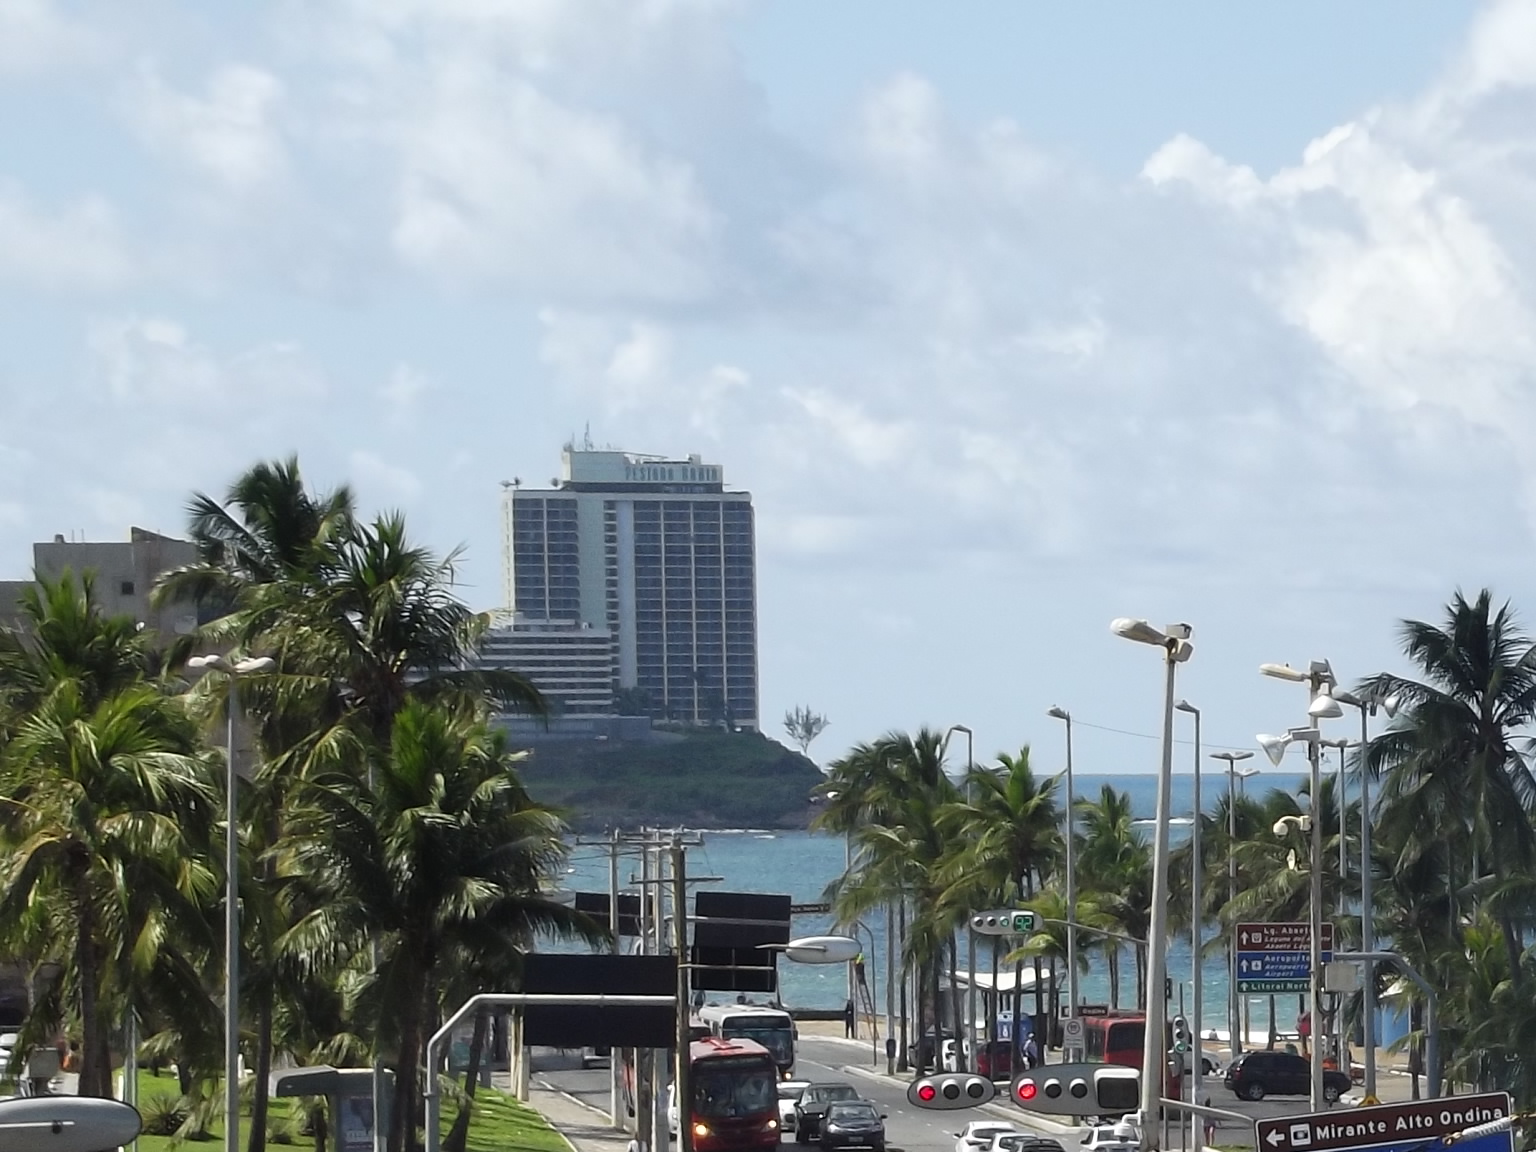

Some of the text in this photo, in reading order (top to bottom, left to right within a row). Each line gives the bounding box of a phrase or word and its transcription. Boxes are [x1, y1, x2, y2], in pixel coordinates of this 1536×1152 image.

[1316, 1107, 1503, 1141] Mirante Alto Ondina
